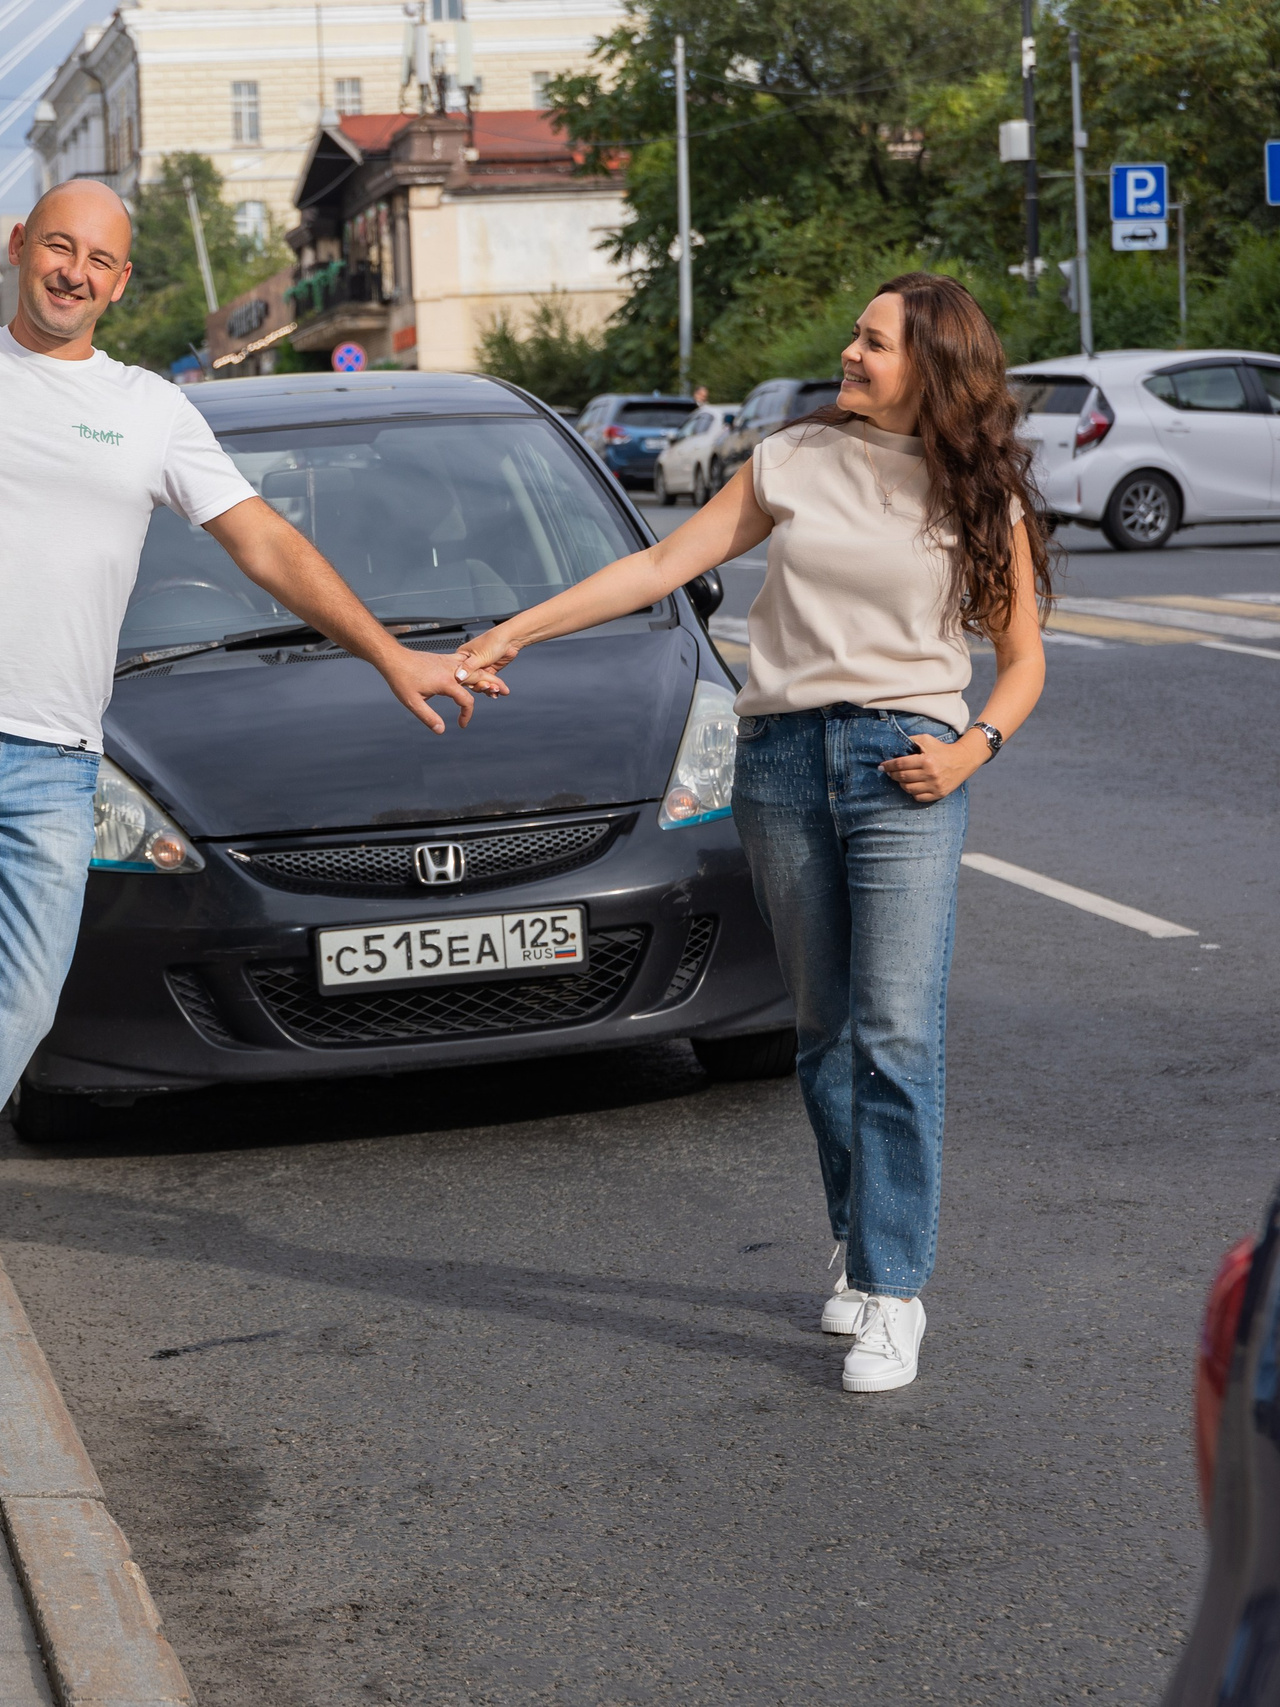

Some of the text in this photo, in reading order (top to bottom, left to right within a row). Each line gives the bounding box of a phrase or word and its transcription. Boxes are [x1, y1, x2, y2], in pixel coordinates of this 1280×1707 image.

[1126, 169, 1157, 216] P
[509, 915, 570, 949] 125
[522, 948, 554, 961] RUS
